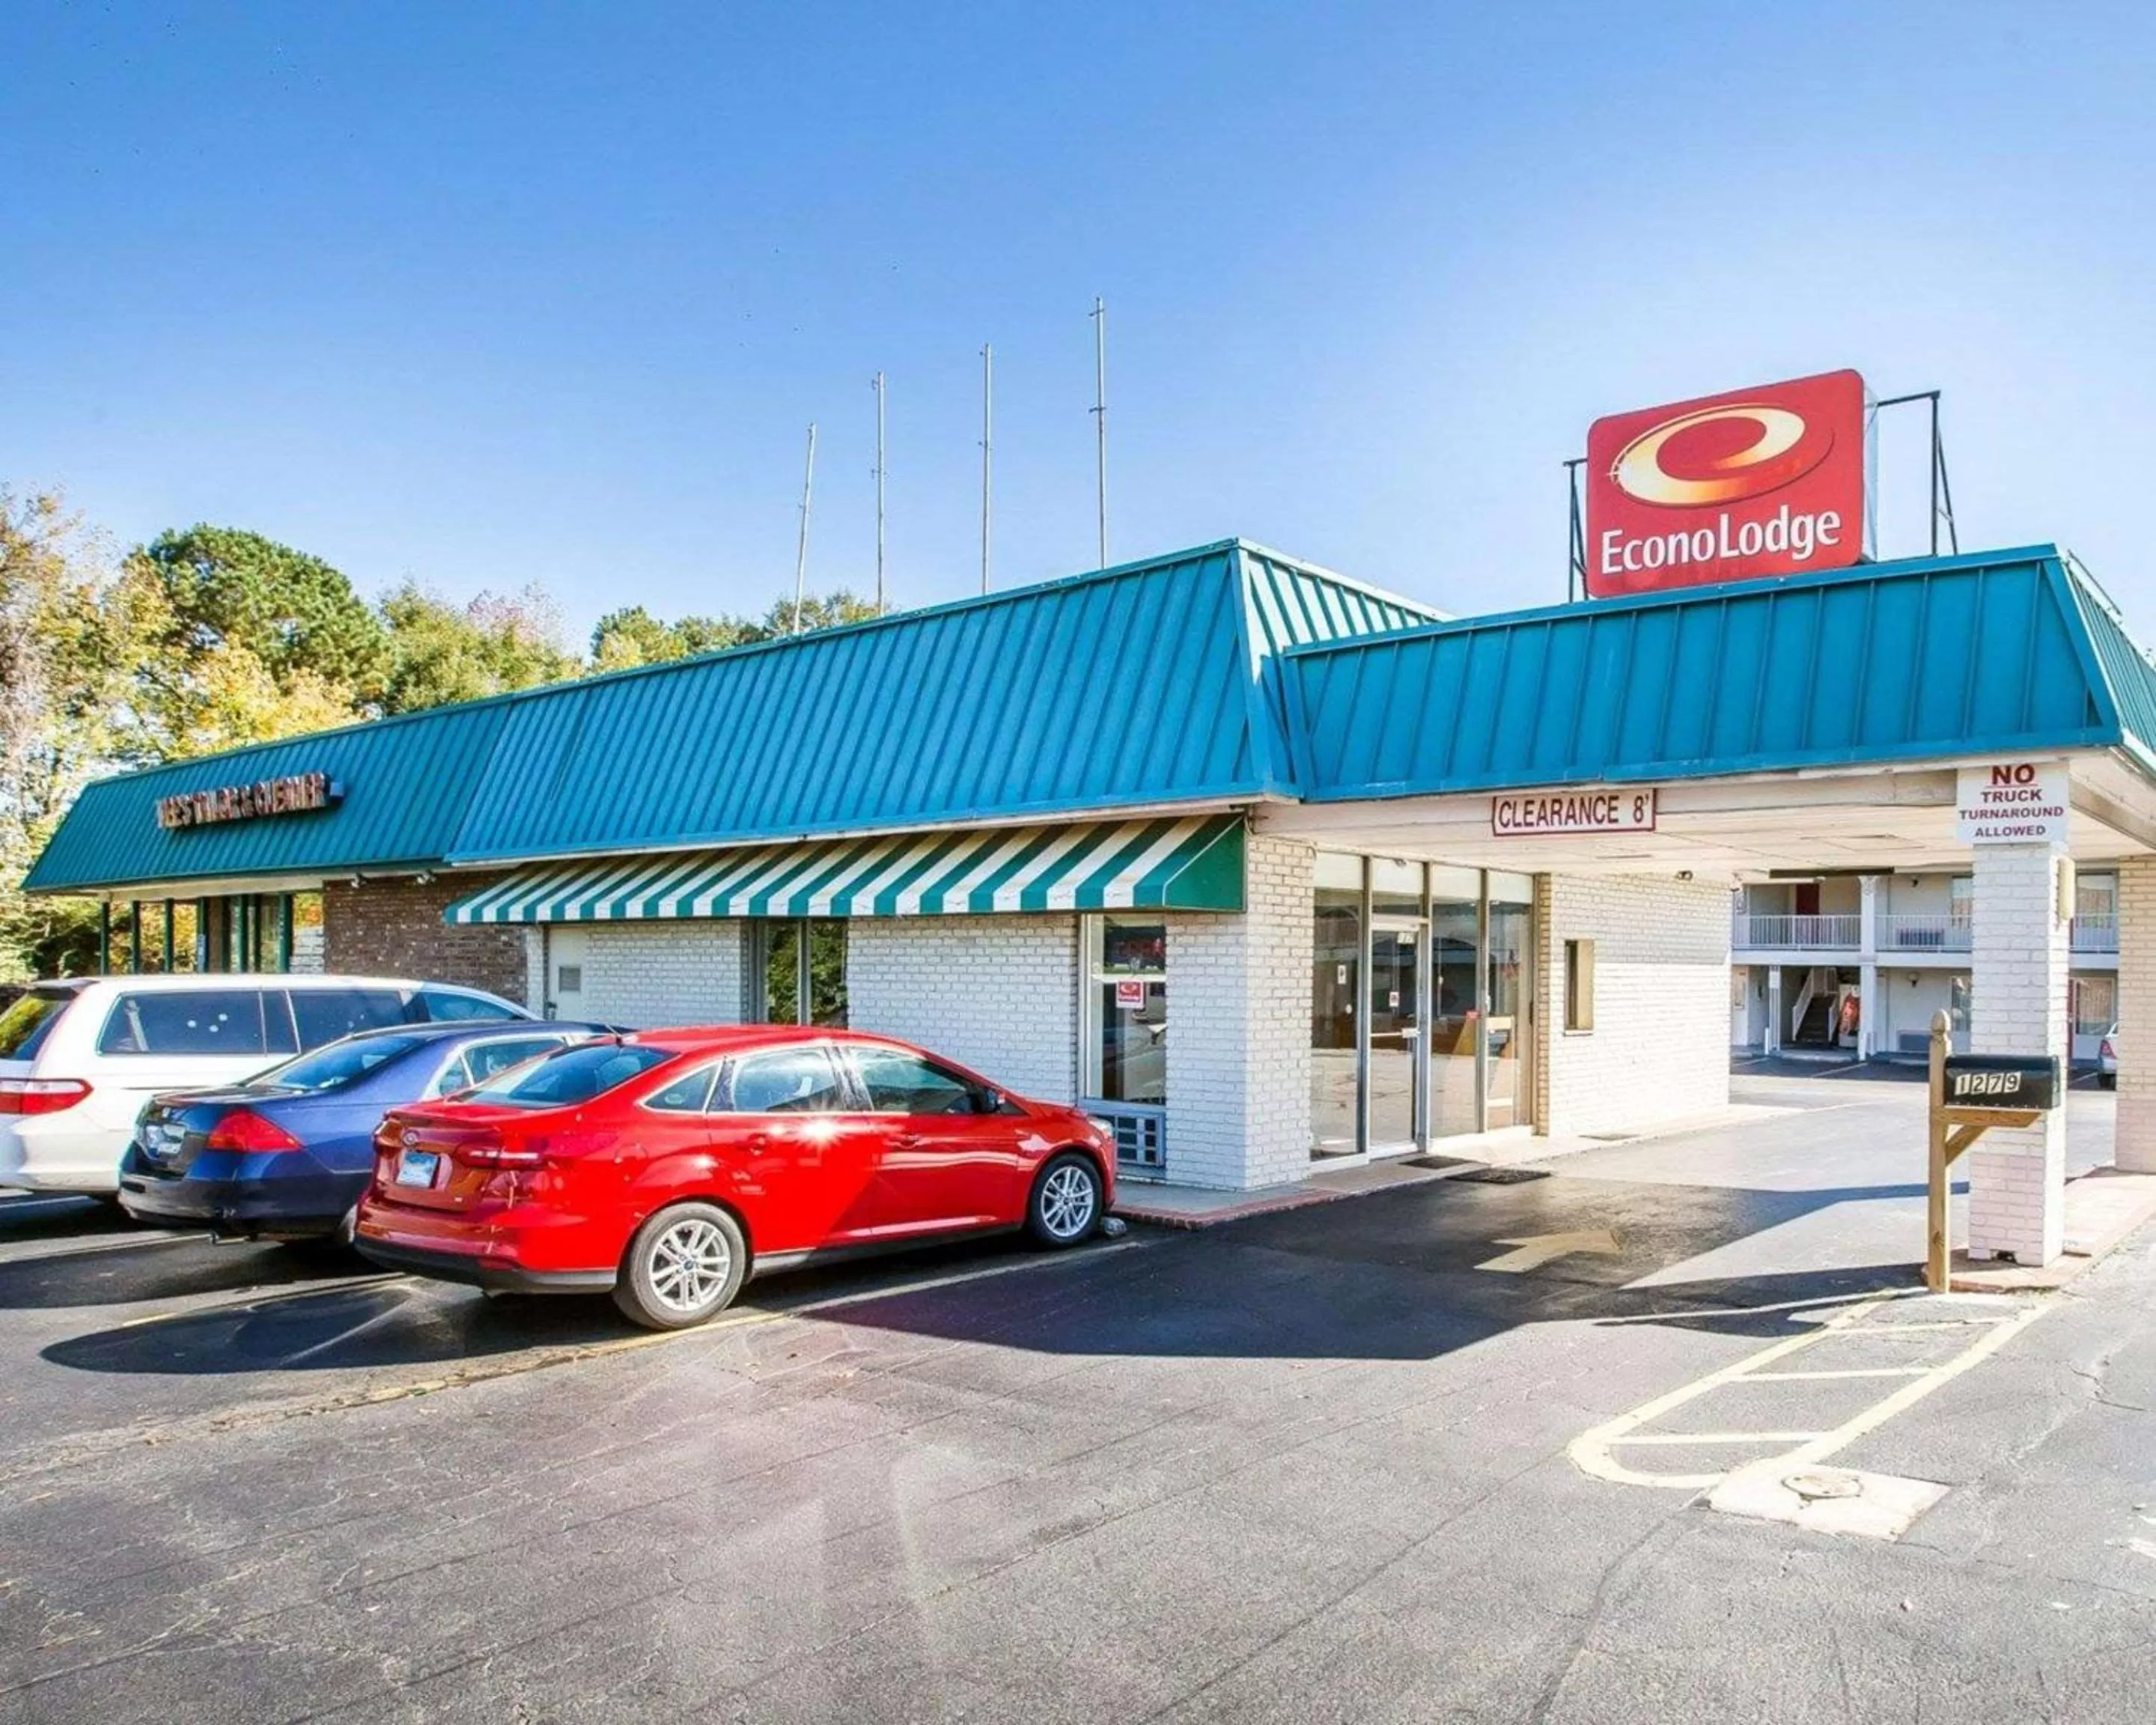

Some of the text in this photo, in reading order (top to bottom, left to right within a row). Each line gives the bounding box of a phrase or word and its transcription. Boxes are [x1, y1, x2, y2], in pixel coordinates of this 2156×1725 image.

[1991, 763, 2035, 785] NO
[1981, 788, 2043, 803] TRUCK
[1498, 793, 1650, 829] CLEARANCE 8'
[1958, 806, 2065, 821] TURNAROUND
[1974, 824, 2047, 838] ALLOWED
[1958, 1072, 2019, 1094] 1279
